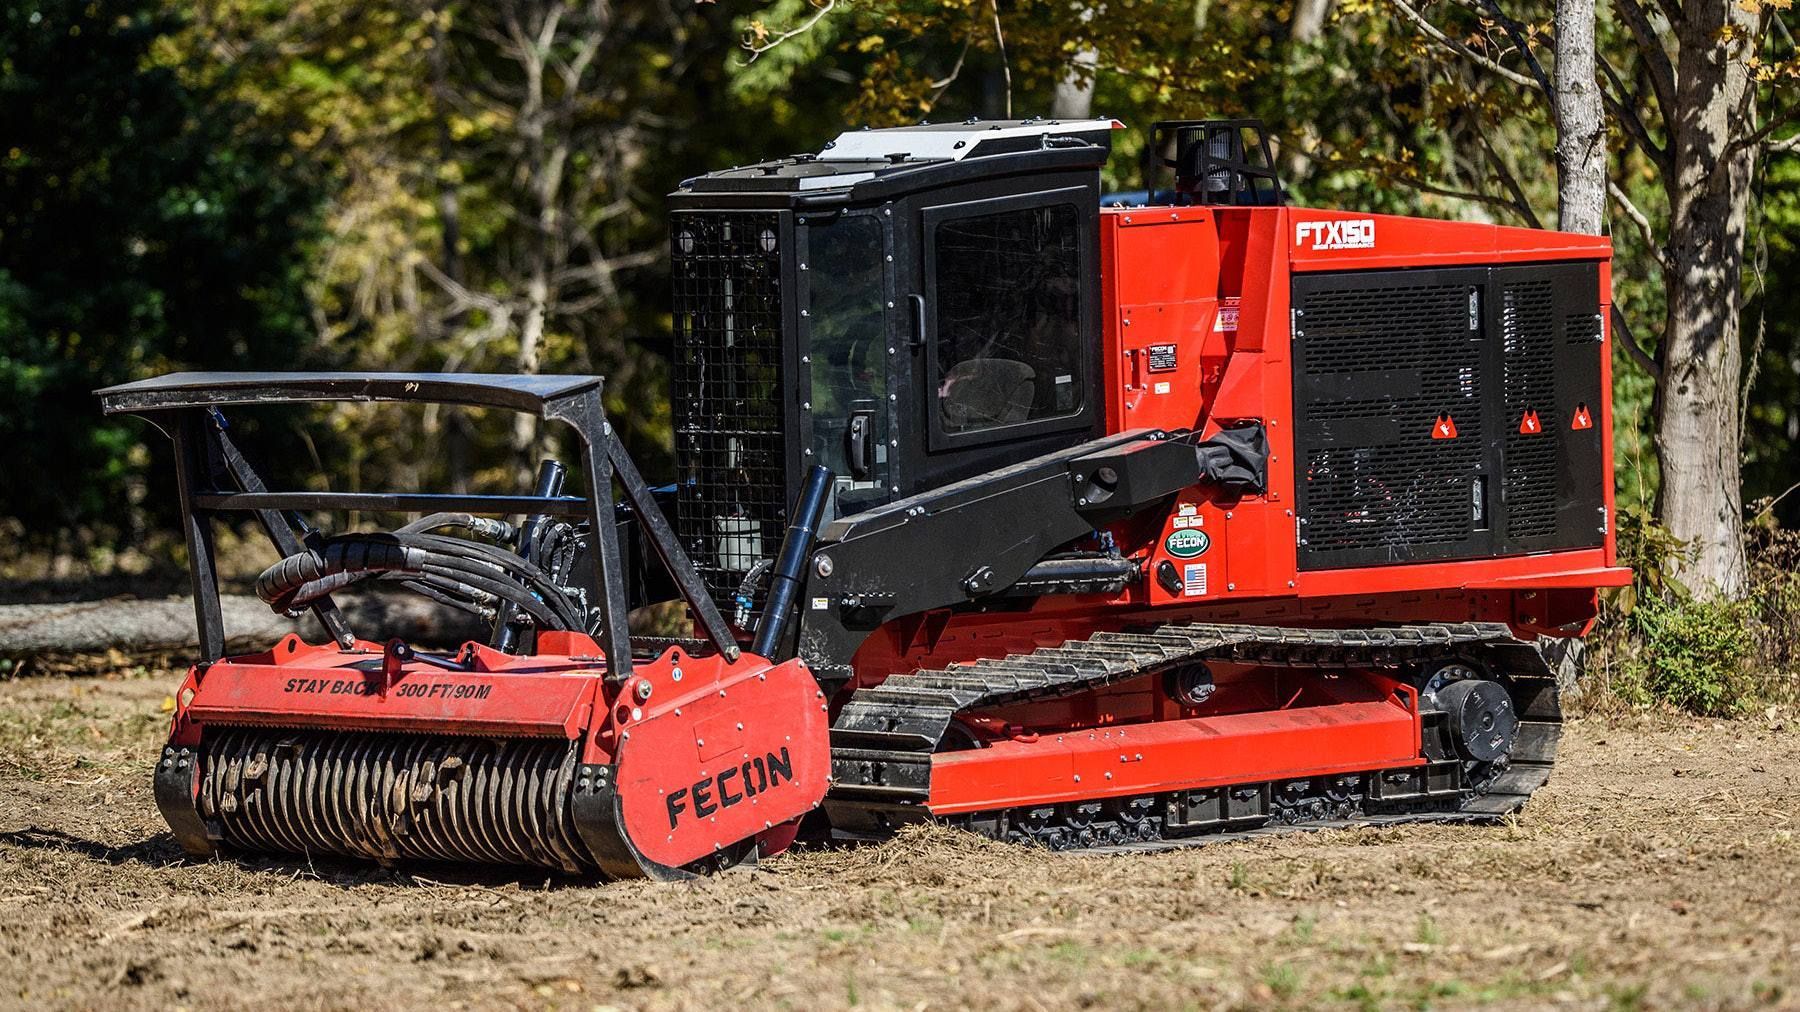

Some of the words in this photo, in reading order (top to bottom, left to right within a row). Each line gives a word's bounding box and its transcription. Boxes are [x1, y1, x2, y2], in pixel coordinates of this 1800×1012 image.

[1296, 219, 1375, 246] FTX150
[1169, 537, 1204, 549] FECON
[284, 678, 330, 693] STAY
[396, 683, 428, 698] 300
[666, 746, 793, 830] FECON
